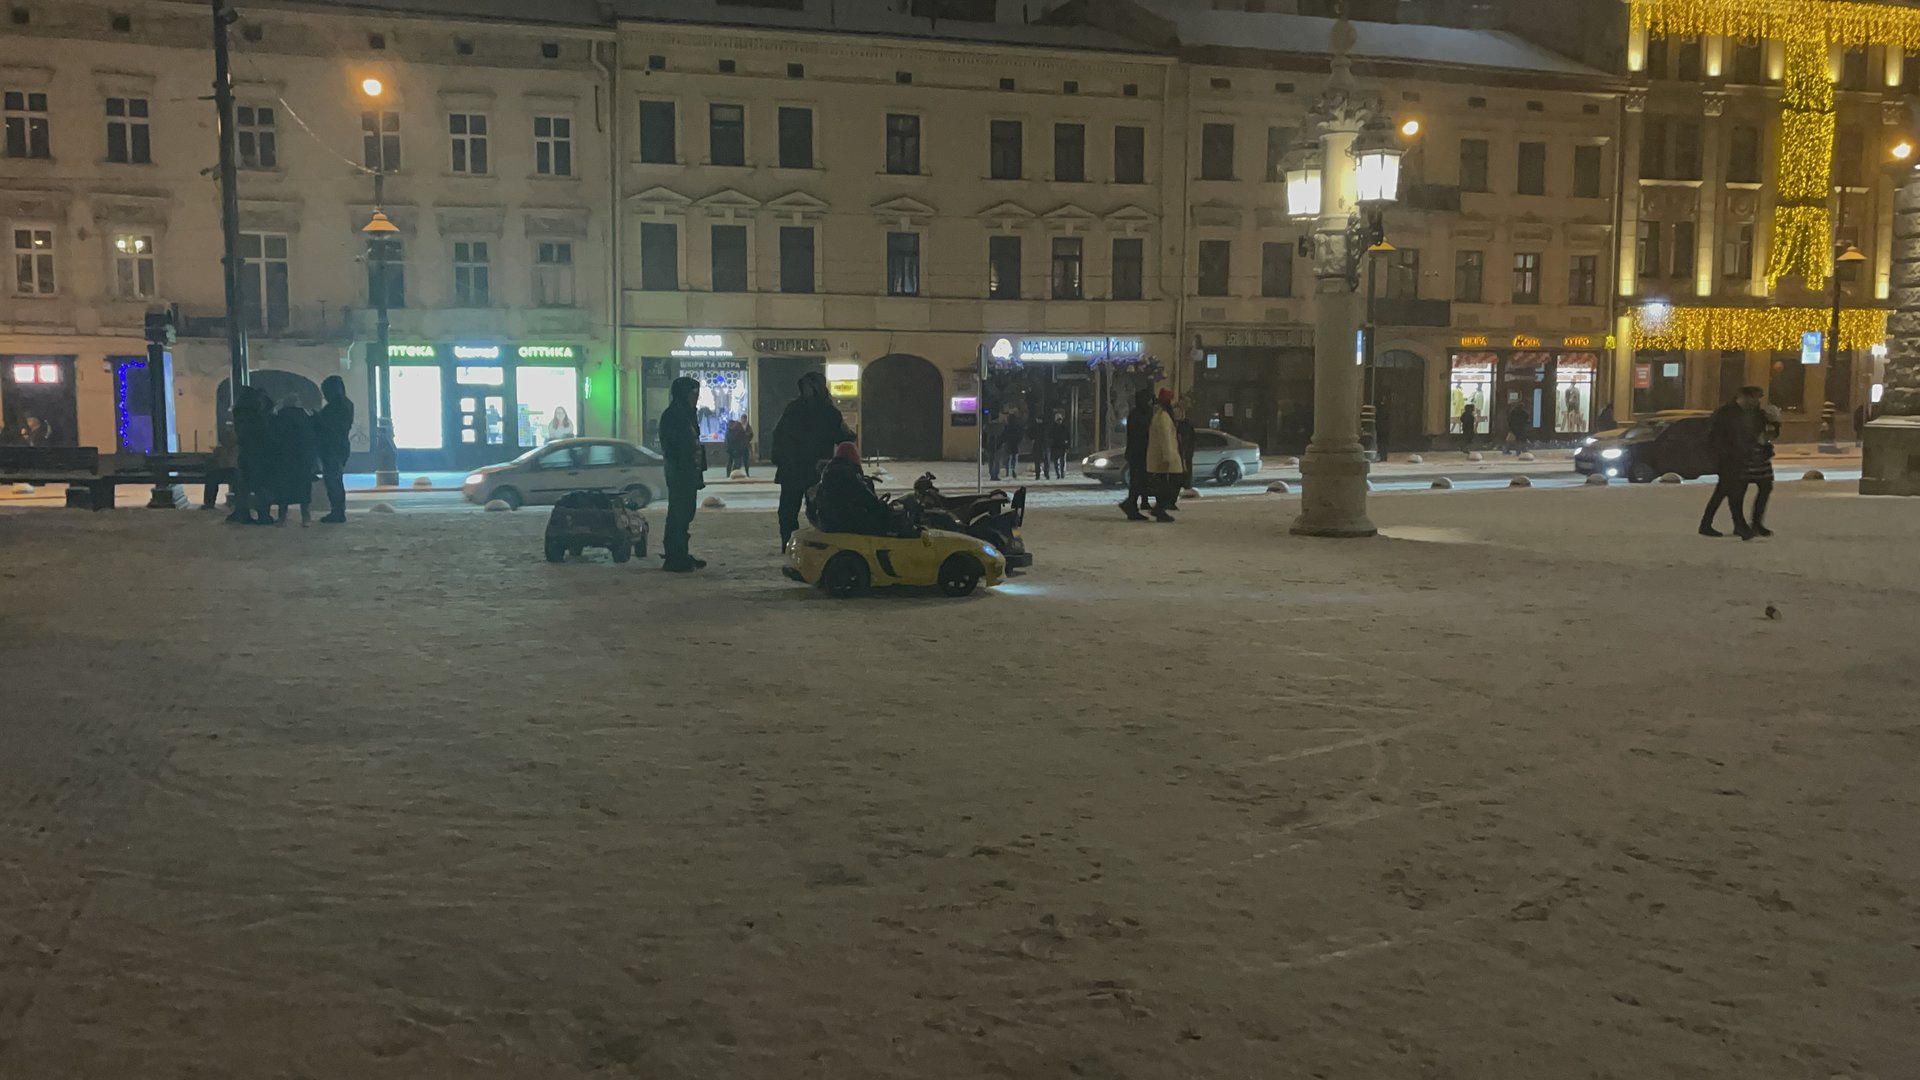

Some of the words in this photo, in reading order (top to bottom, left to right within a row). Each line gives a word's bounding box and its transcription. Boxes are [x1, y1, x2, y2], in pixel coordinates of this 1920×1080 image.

[388, 345, 434, 357] ПТЕКА
[518, 346, 573, 357] ОПТИКА
[1021, 338, 1120, 353] МАРМЕЛАДНИЙ
[1122, 340, 1142, 351] КІТ
